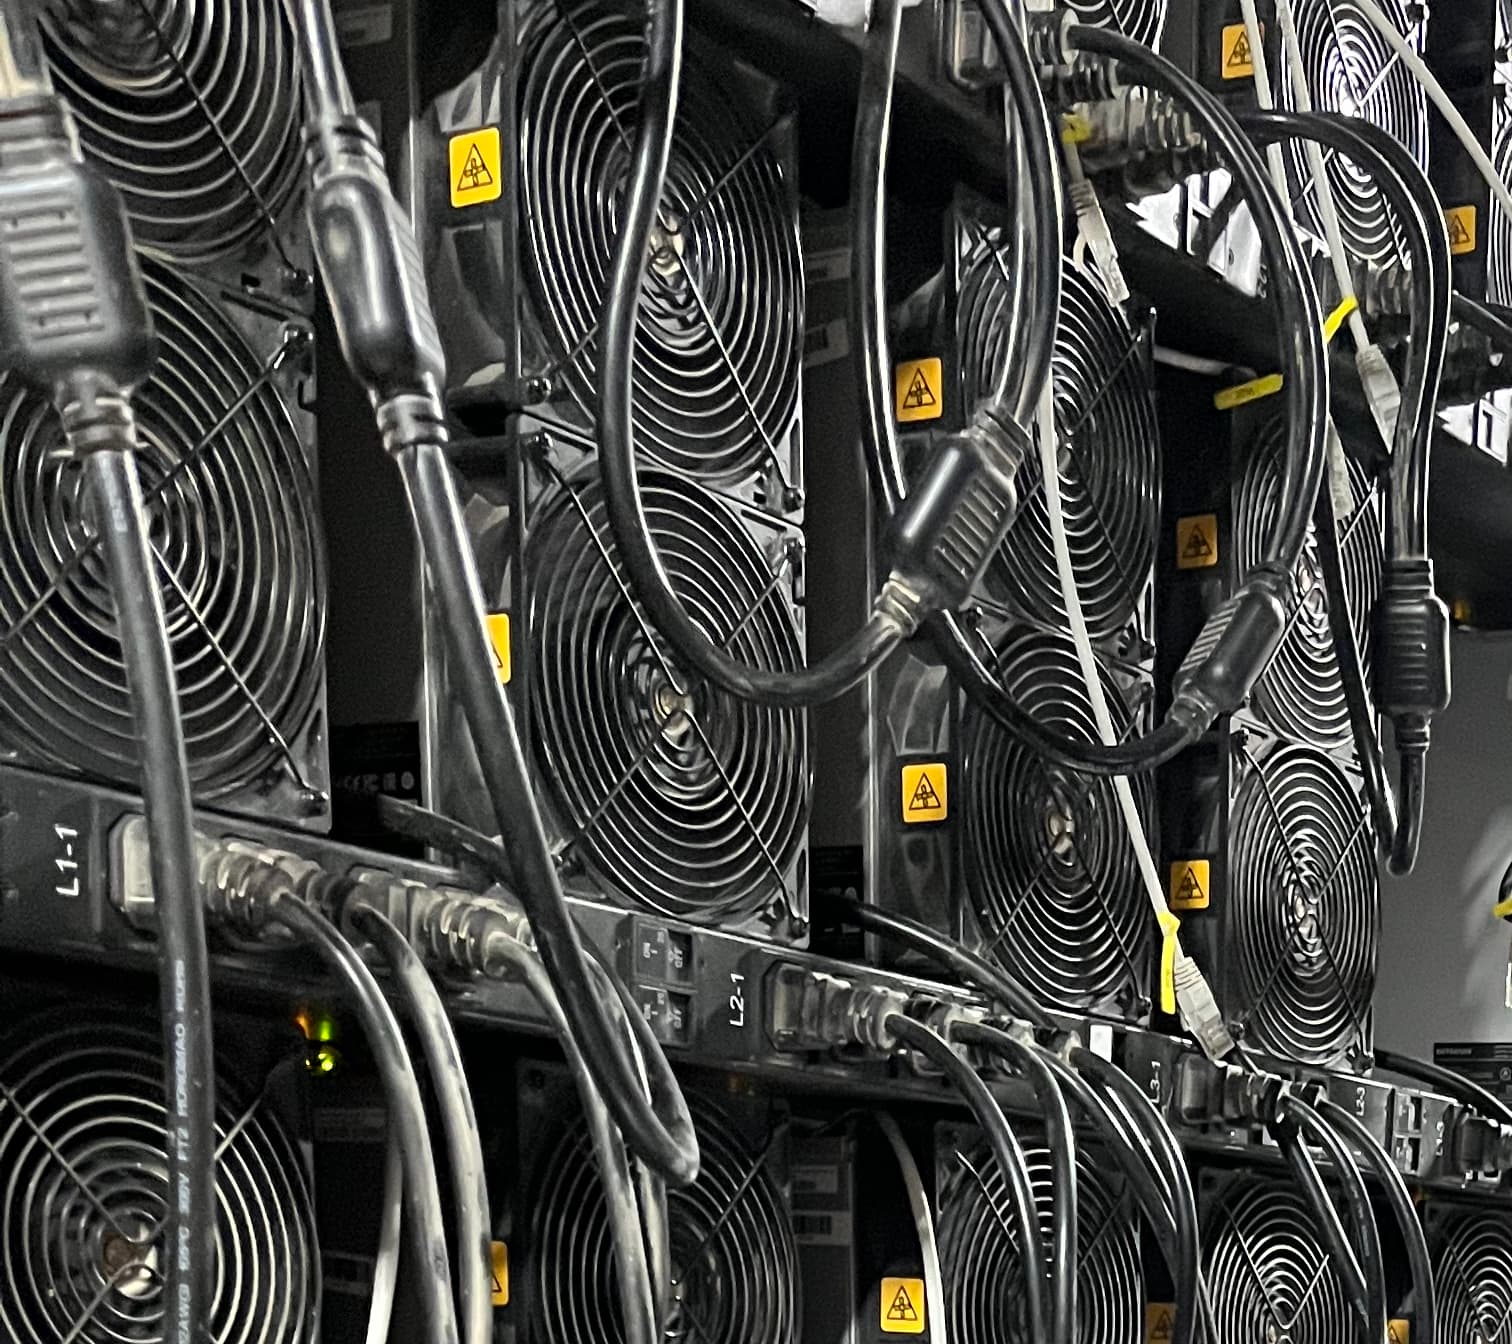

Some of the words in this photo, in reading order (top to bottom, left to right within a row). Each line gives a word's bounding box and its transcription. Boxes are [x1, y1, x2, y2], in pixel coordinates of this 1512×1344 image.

[54, 823, 80, 897] L1-1
[729, 972, 746, 1028] L2-1
[1150, 1061, 1162, 1103] L3-1
